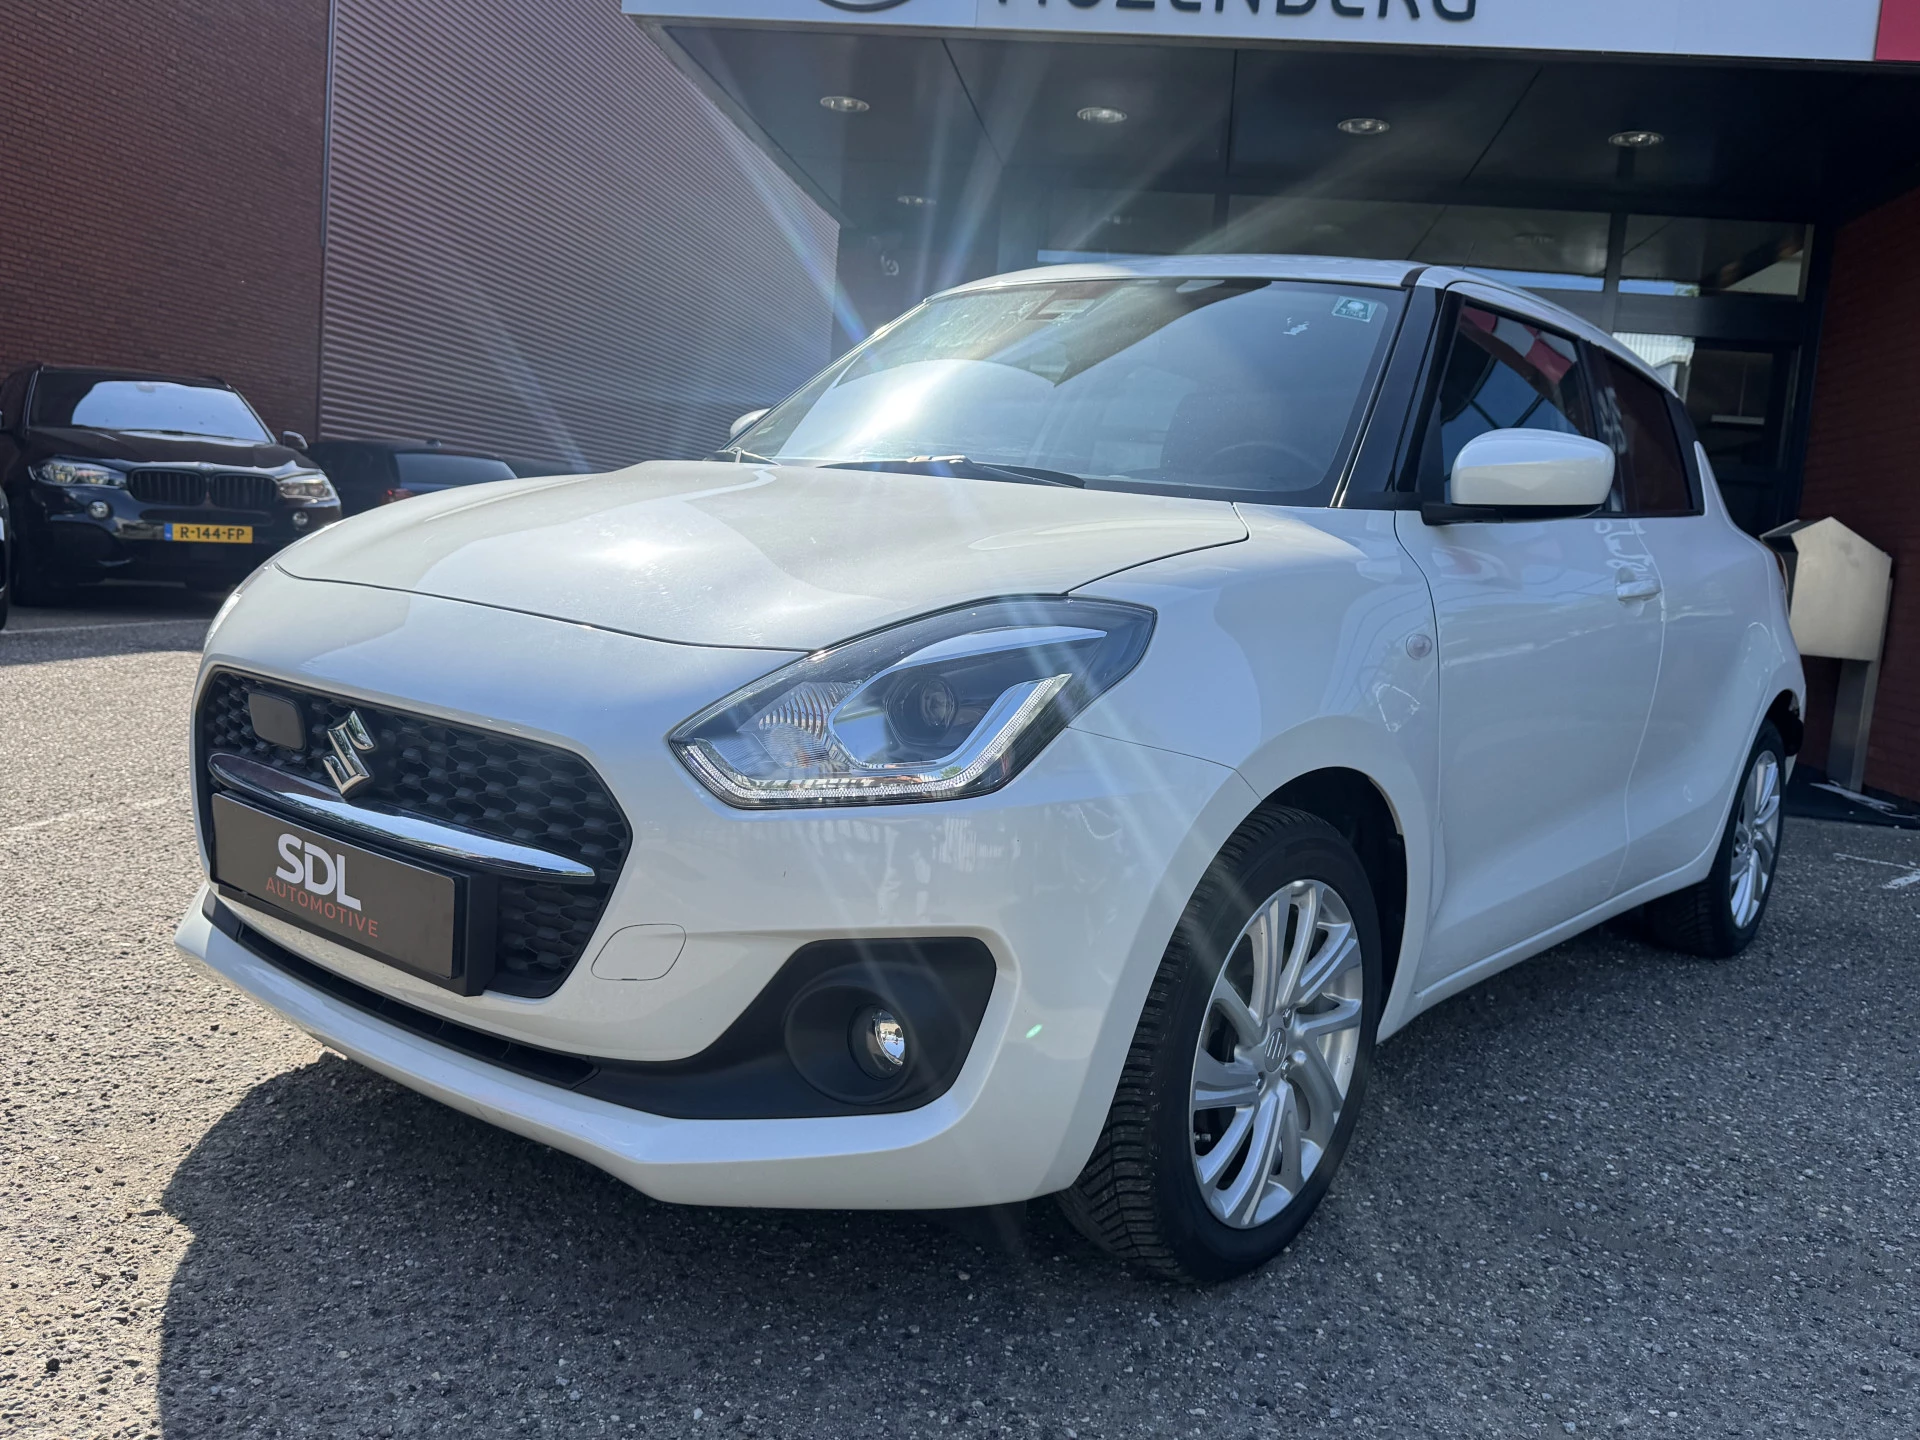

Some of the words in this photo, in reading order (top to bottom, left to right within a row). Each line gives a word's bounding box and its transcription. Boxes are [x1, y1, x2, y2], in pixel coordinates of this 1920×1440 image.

[180, 526, 245, 540] R-144-FP
[275, 833, 362, 911] SDL
[265, 876, 379, 938] AUTOMOTIVE
